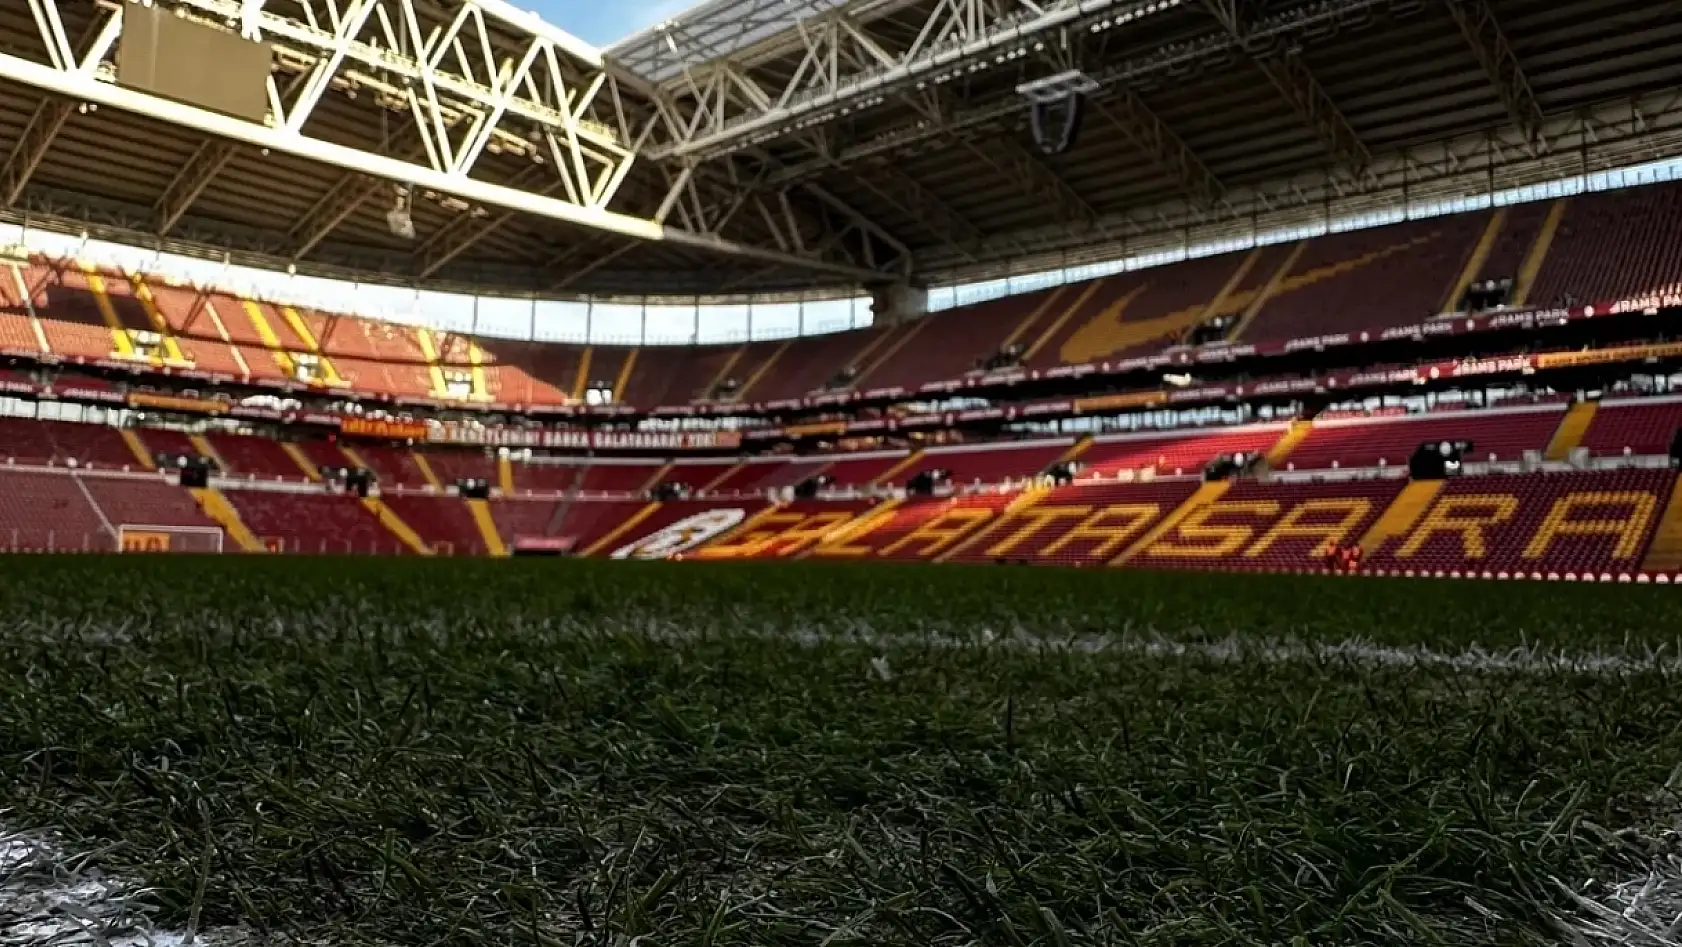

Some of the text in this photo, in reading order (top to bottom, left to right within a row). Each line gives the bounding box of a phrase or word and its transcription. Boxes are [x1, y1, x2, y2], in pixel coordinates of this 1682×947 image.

[1620, 296, 1661, 313] RAMS
[1498, 309, 1569, 326] RAMS PARK
[1461, 361, 1496, 374] RAMS
[1498, 358, 1531, 371] PARK
